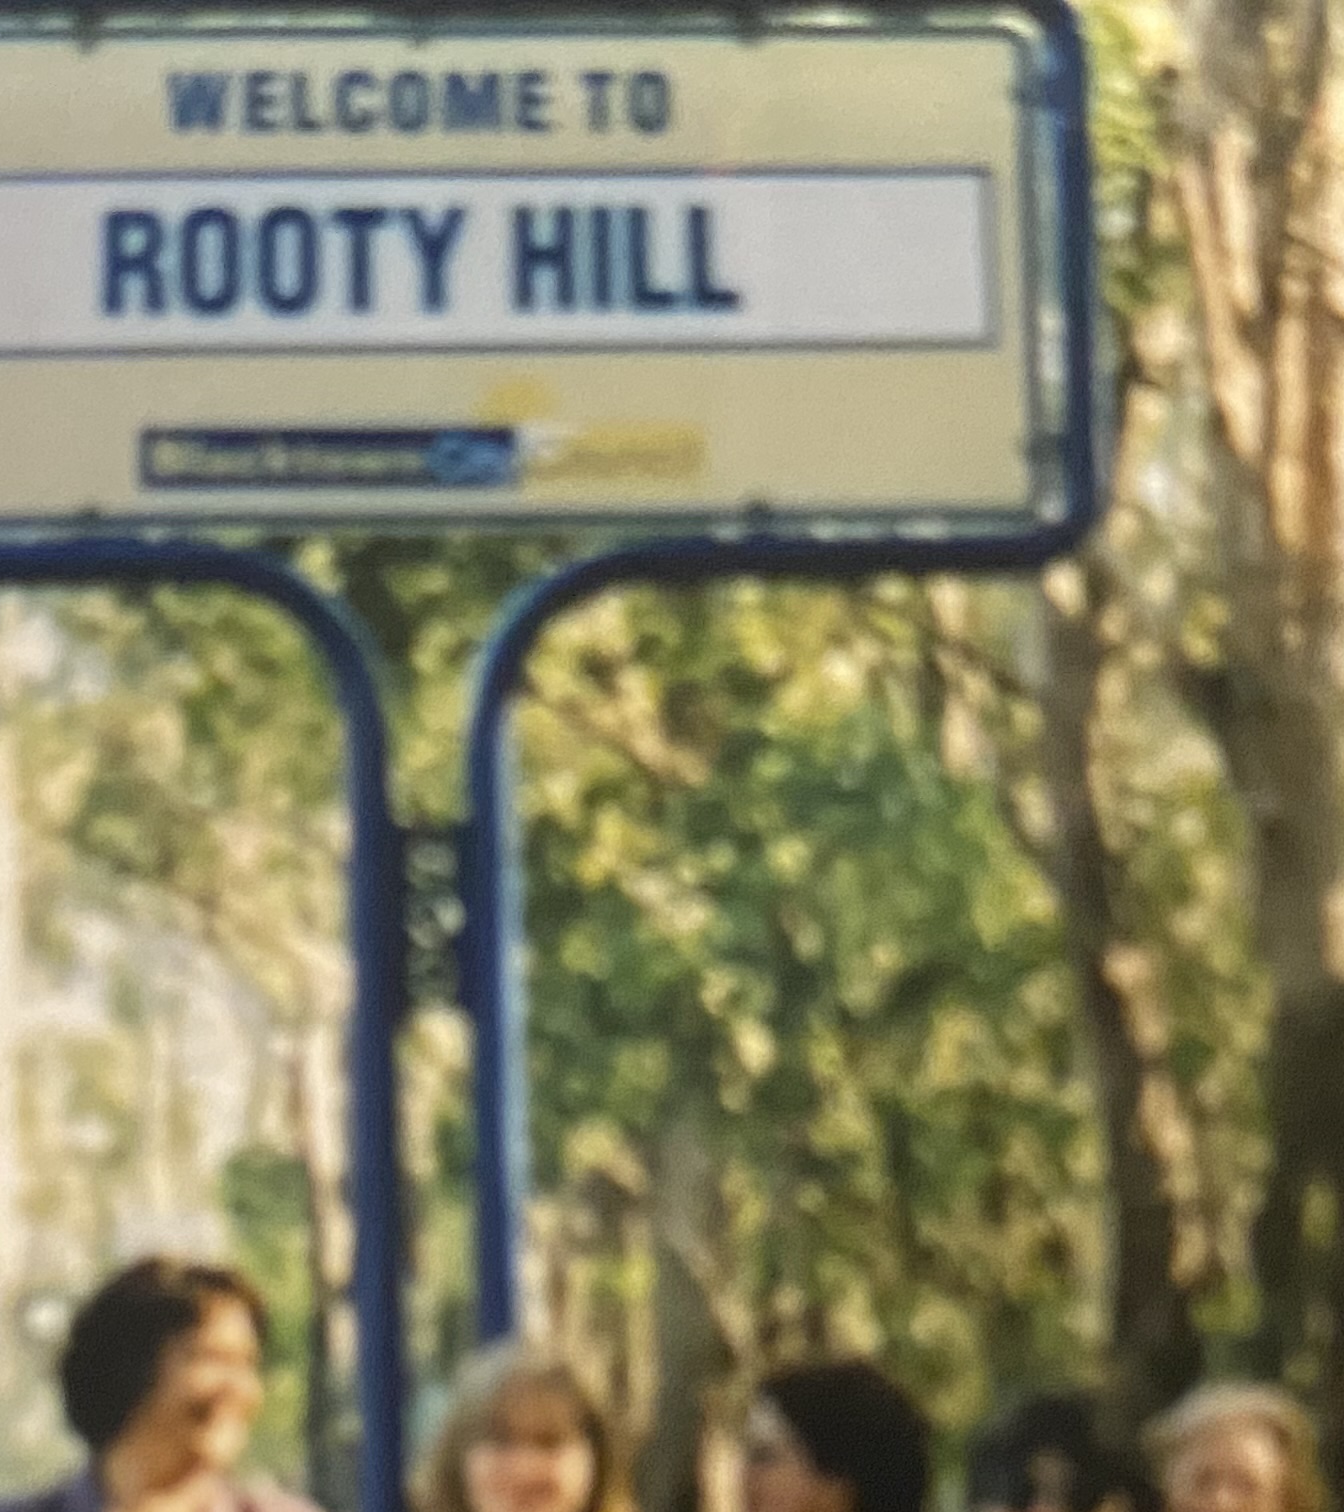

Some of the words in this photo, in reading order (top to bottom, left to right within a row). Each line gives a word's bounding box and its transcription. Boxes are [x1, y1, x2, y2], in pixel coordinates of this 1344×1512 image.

[166, 68, 555, 135] WELCOME
[578, 70, 674, 133] TO
[100, 205, 468, 317] ROOTY
[510, 205, 741, 313] HILL
